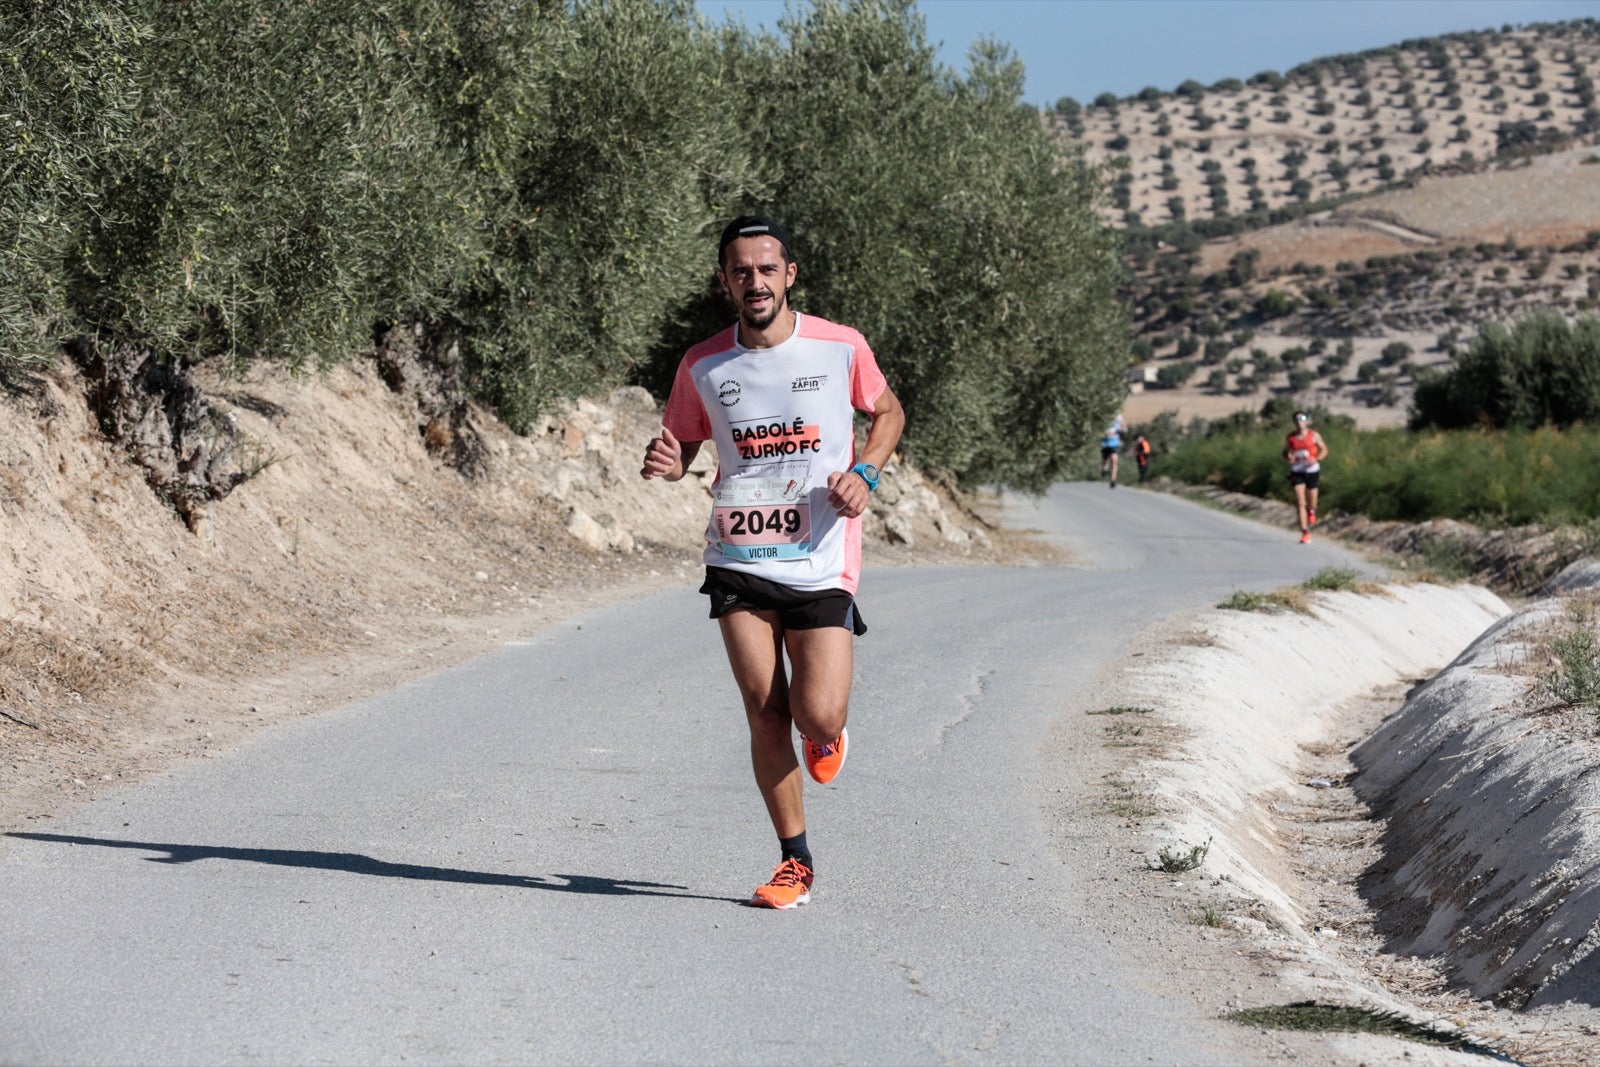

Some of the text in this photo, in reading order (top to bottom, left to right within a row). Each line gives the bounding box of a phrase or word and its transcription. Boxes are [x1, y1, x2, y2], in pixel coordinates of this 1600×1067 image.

[732, 417, 804, 442] BABOLÉ
[729, 509, 801, 535] 2049
[748, 547, 778, 558] VICTOR
